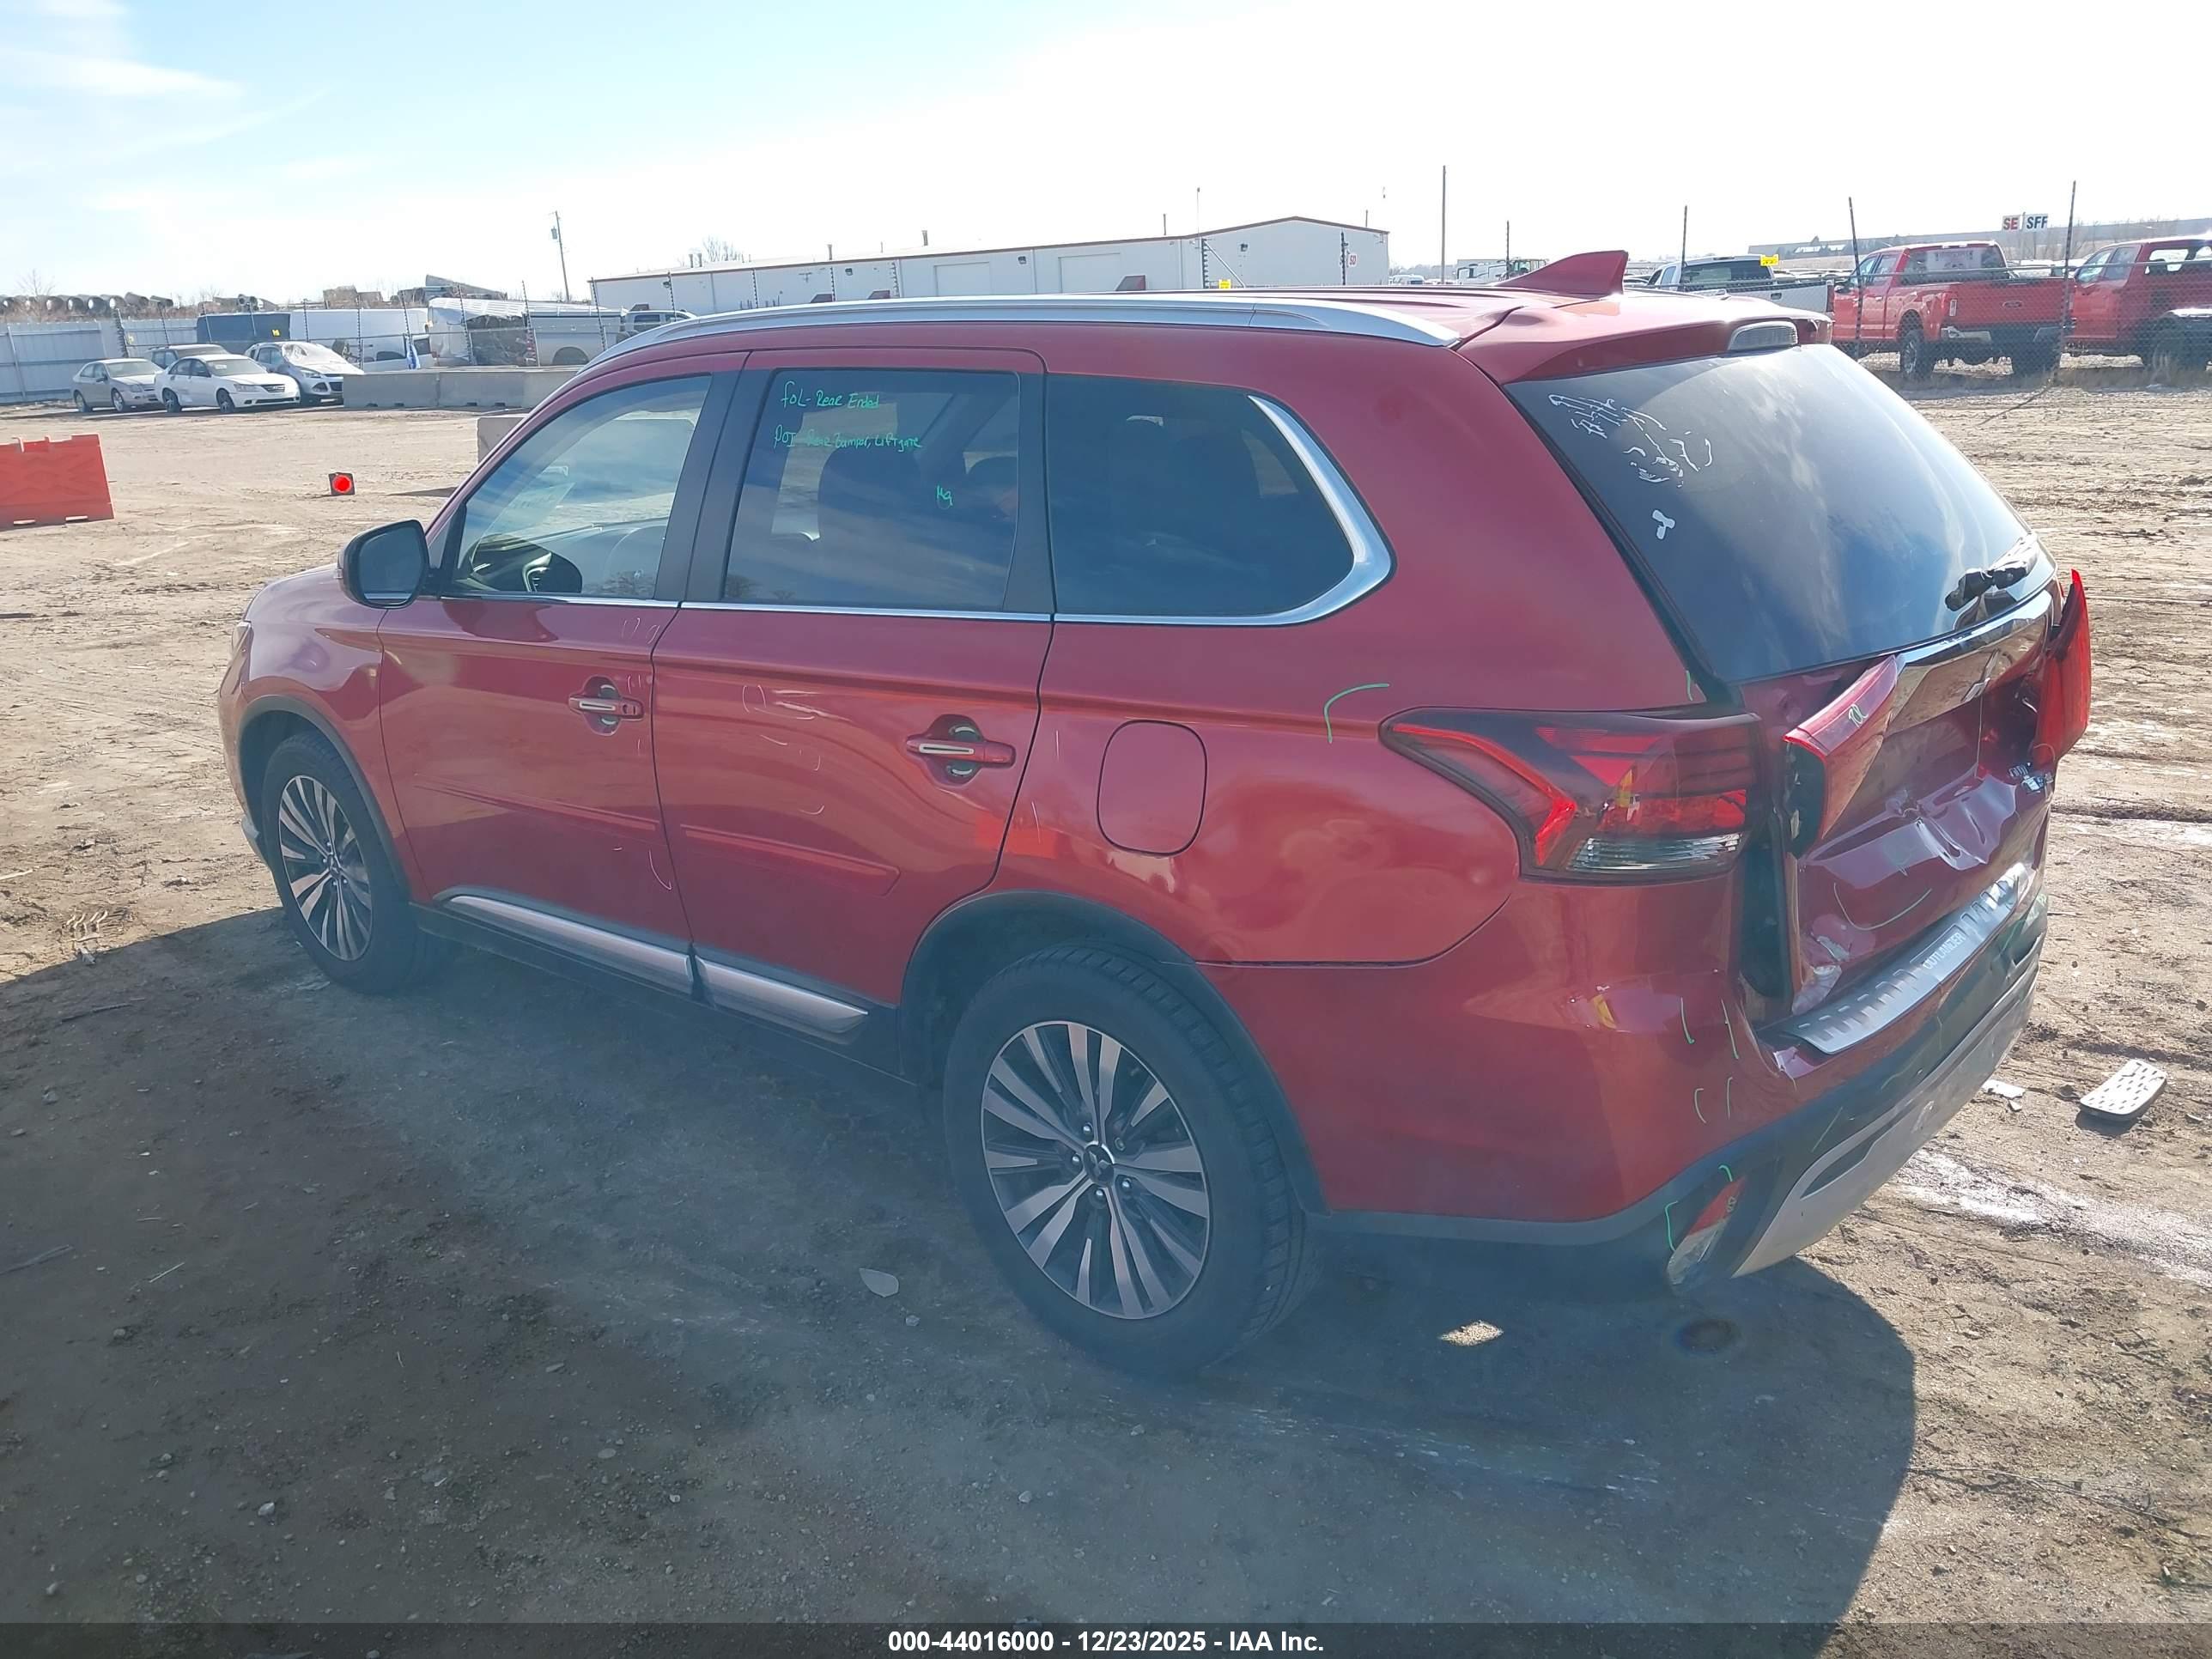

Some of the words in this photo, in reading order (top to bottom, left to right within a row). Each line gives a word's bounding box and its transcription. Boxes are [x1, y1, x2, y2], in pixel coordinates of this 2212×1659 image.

[2003, 217, 2018, 231] SE
[2026, 215, 2048, 229] SFF
[1923, 932, 1966, 969] OUTLANDER
